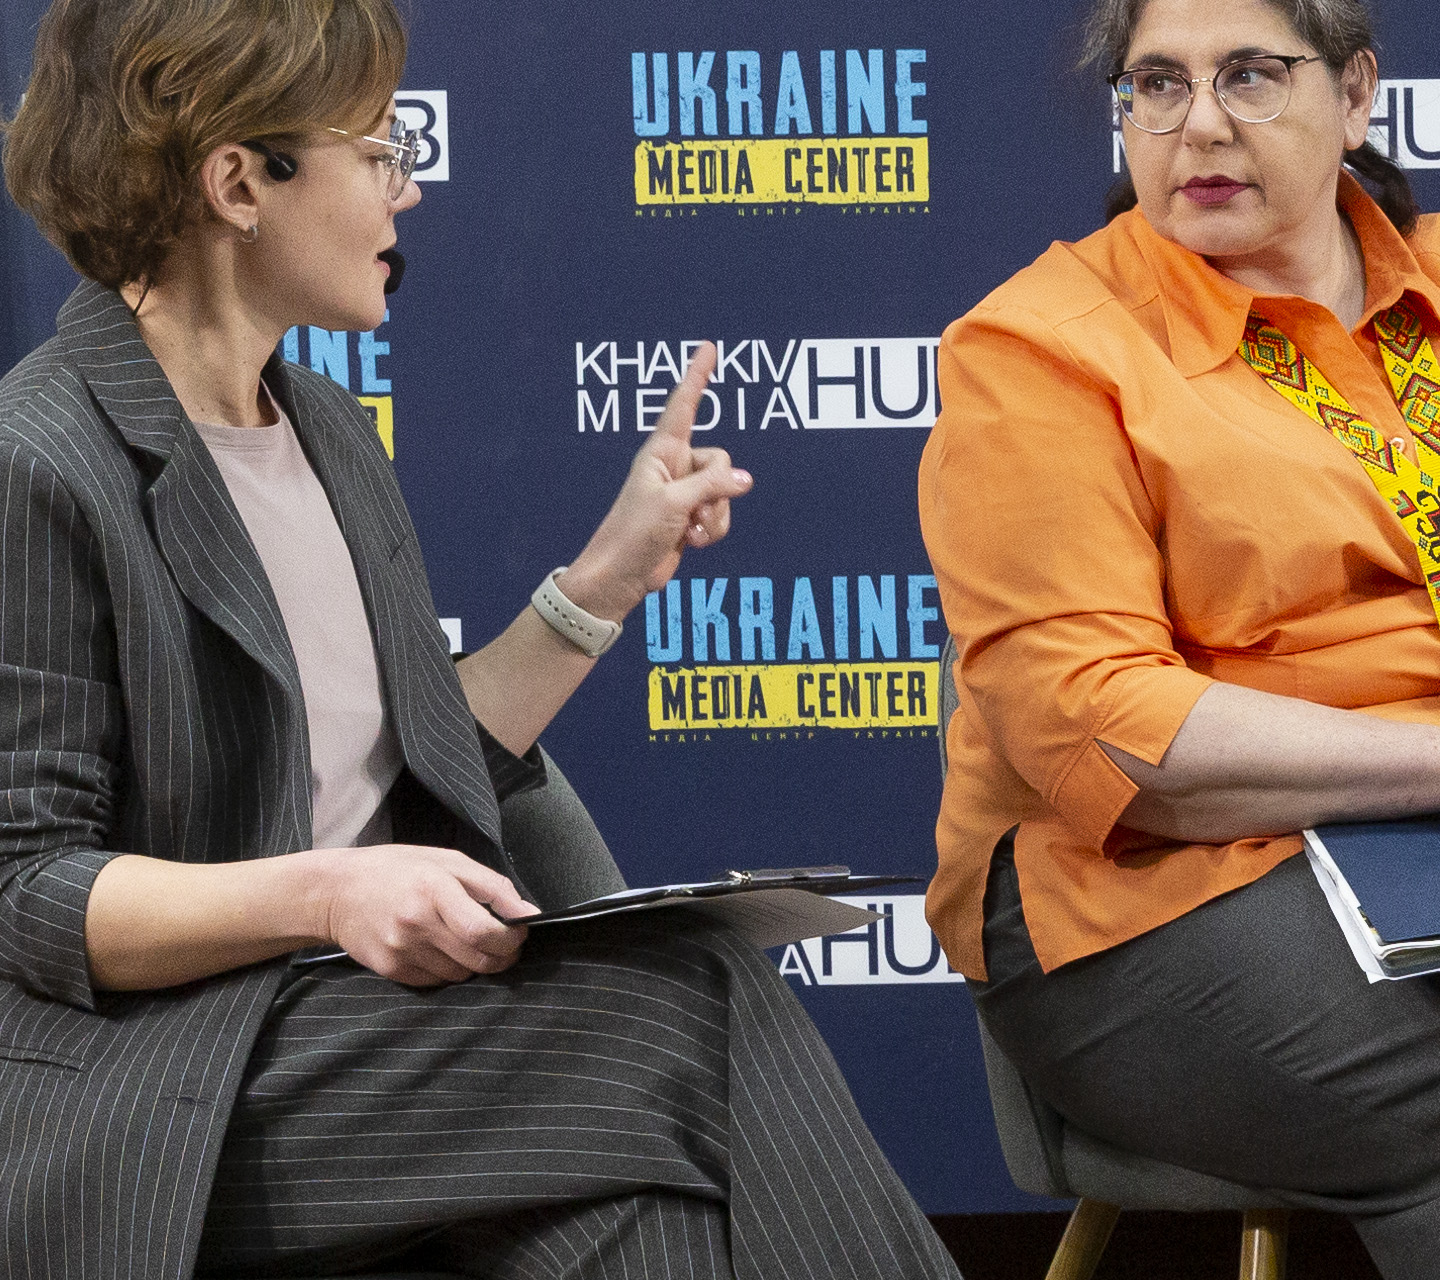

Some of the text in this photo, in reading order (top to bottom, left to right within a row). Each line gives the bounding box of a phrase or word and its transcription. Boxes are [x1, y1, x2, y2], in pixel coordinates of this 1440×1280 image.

[631, 49, 928, 136] UKRAINE
[648, 147, 914, 195] MEDIA CENTER
[576, 339, 796, 386] KHARKIV
[807, 345, 941, 420] HU
[577, 387, 798, 432] MEDIA
[645, 575, 939, 663] UKRAINE
[661, 671, 926, 720] MEDIA CENTER
[822, 903, 961, 976] HU
